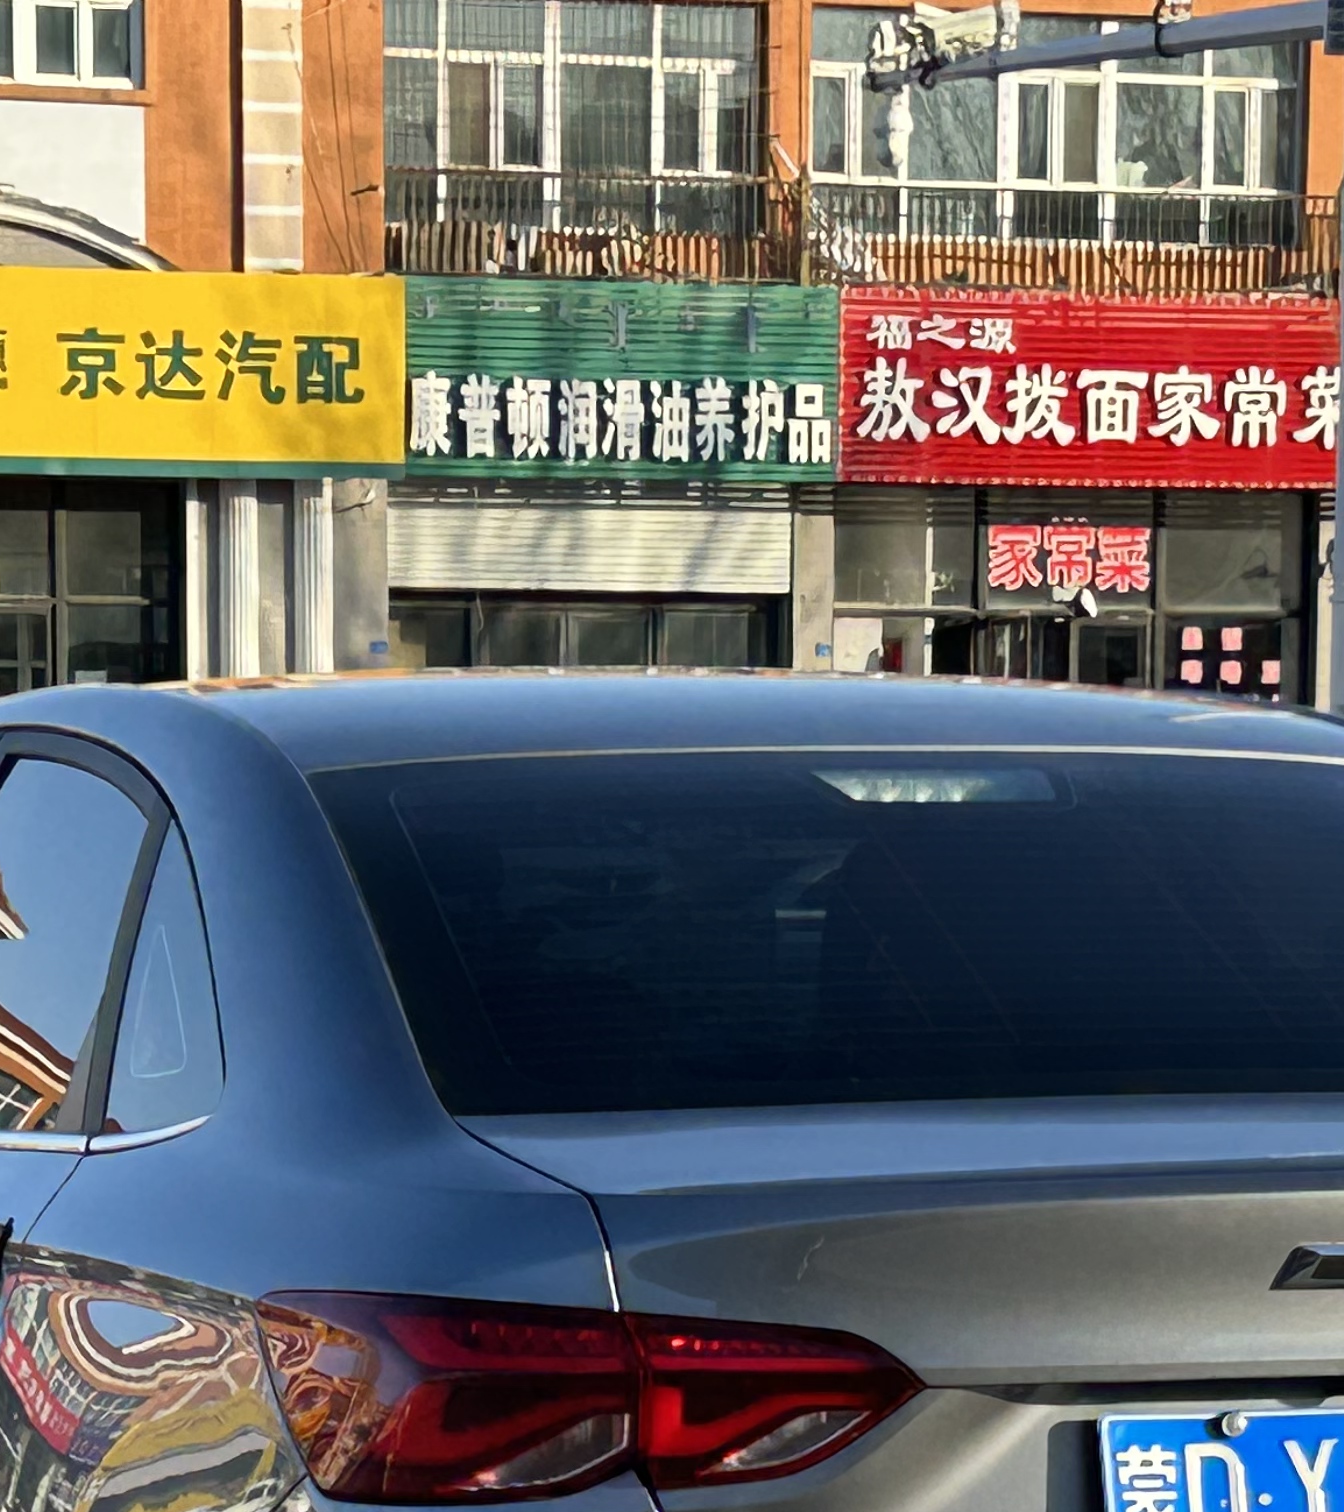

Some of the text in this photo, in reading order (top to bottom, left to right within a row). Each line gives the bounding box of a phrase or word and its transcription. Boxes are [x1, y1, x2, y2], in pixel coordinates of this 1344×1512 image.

[56, 327, 365, 404] 京达汽配
[866, 314, 1017, 353] 福之源
[409, 369, 832, 464] 康普顿润滑油养护品
[987, 516, 1151, 593] 家常菜
